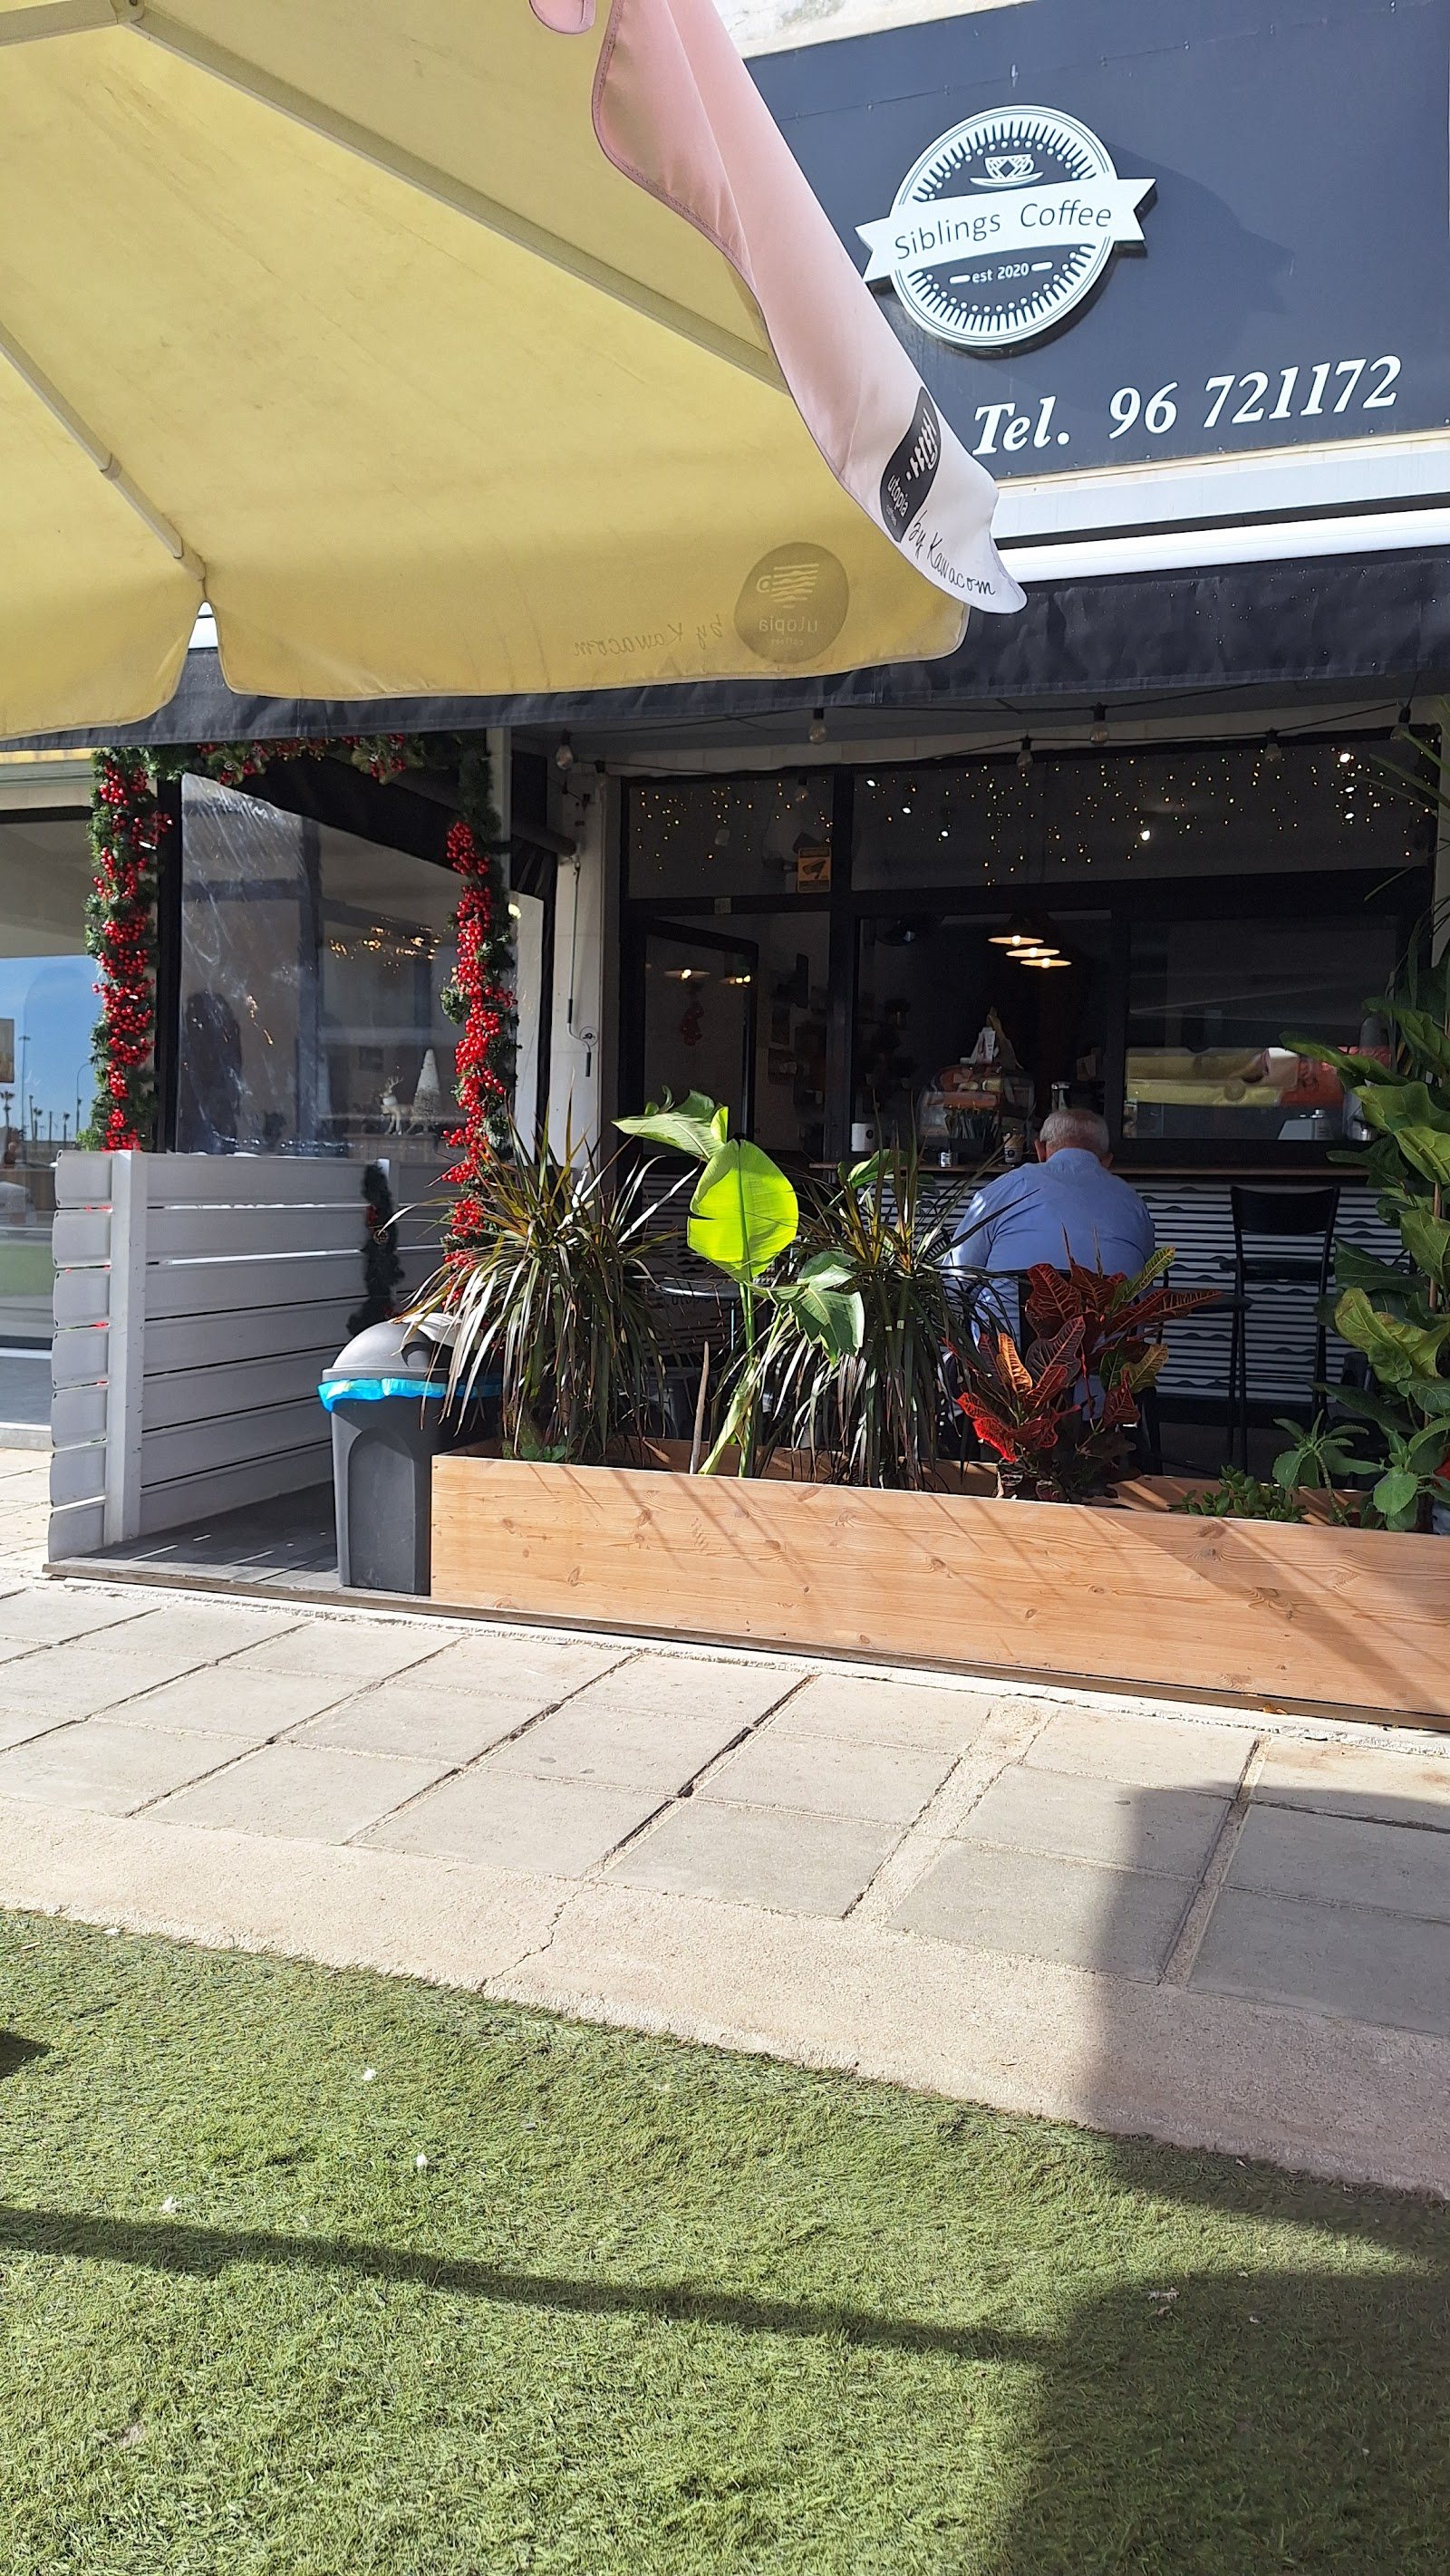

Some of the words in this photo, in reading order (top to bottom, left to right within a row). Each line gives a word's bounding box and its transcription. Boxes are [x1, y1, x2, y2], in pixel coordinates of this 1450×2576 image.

[894, 214, 1000, 259] Siblings
[1020, 199, 1111, 227] Coffee
[972, 268, 992, 283] est
[997, 262, 1030, 278] 2020
[973, 396, 1070, 455] Tel.
[1108, 382, 1178, 439] 96
[1203, 355, 1402, 429] 721172
[887, 475, 909, 517] utopia
[908, 510, 927, 559] by
